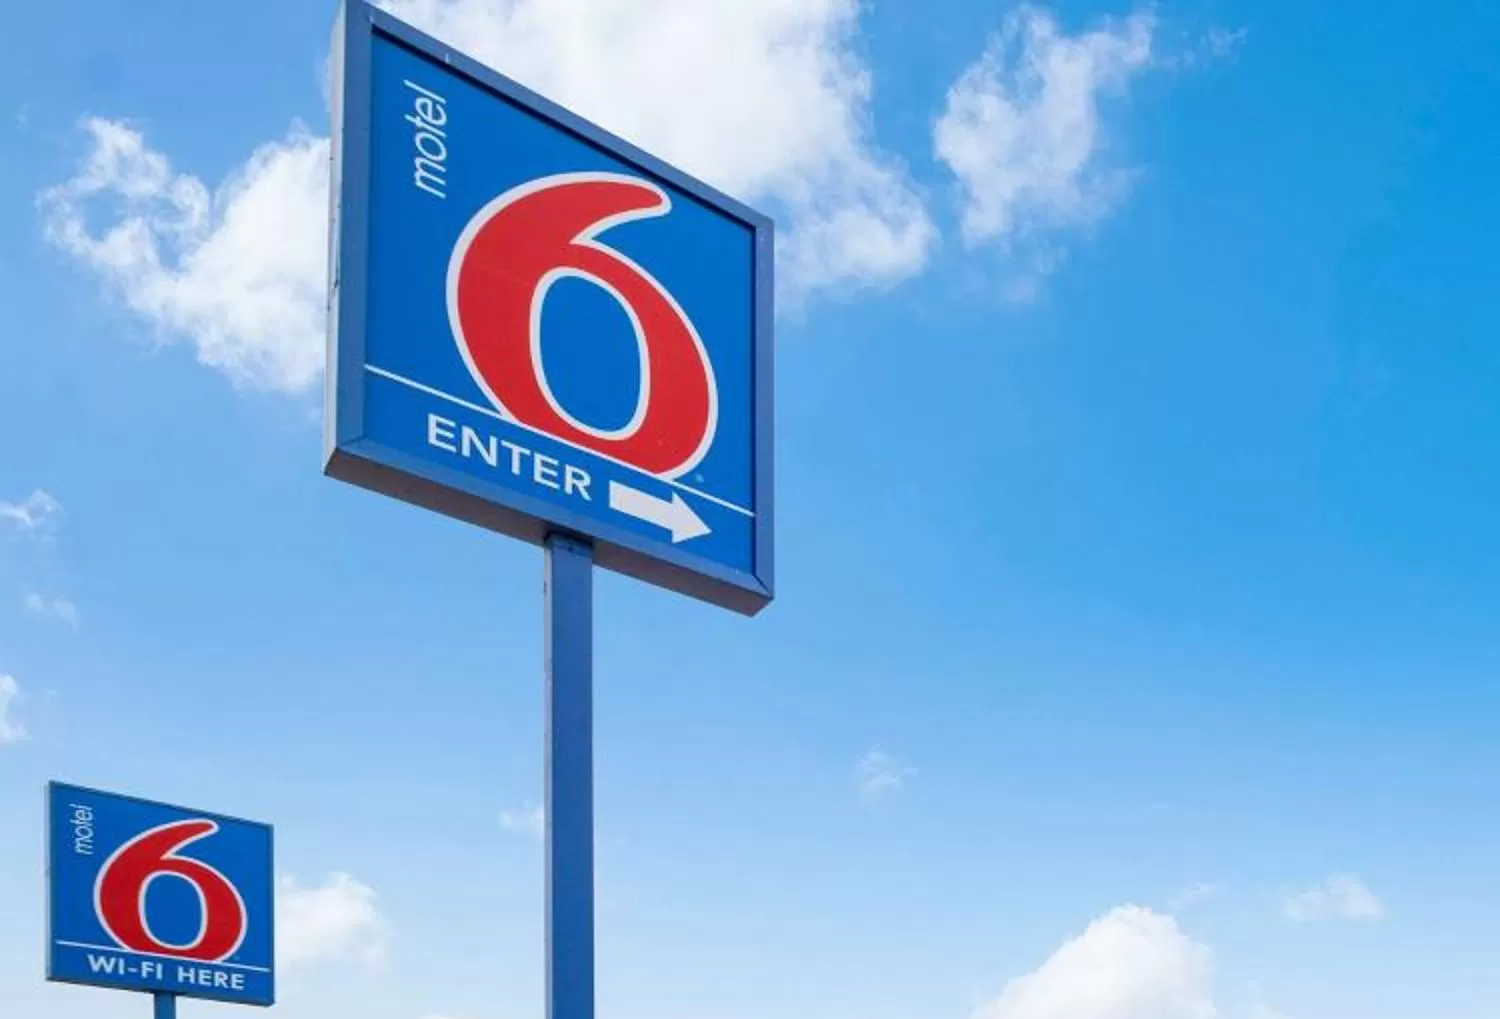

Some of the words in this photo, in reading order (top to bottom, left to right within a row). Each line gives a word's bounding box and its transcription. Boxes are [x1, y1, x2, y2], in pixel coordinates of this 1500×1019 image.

[403, 80, 447, 198] motel
[446, 171, 718, 481] 6
[427, 413, 592, 500] ENTER
[69, 804, 93, 854] motel
[94, 818, 248, 963] 6
[87, 954, 163, 980] WI-FI
[177, 966, 245, 990] HERE
